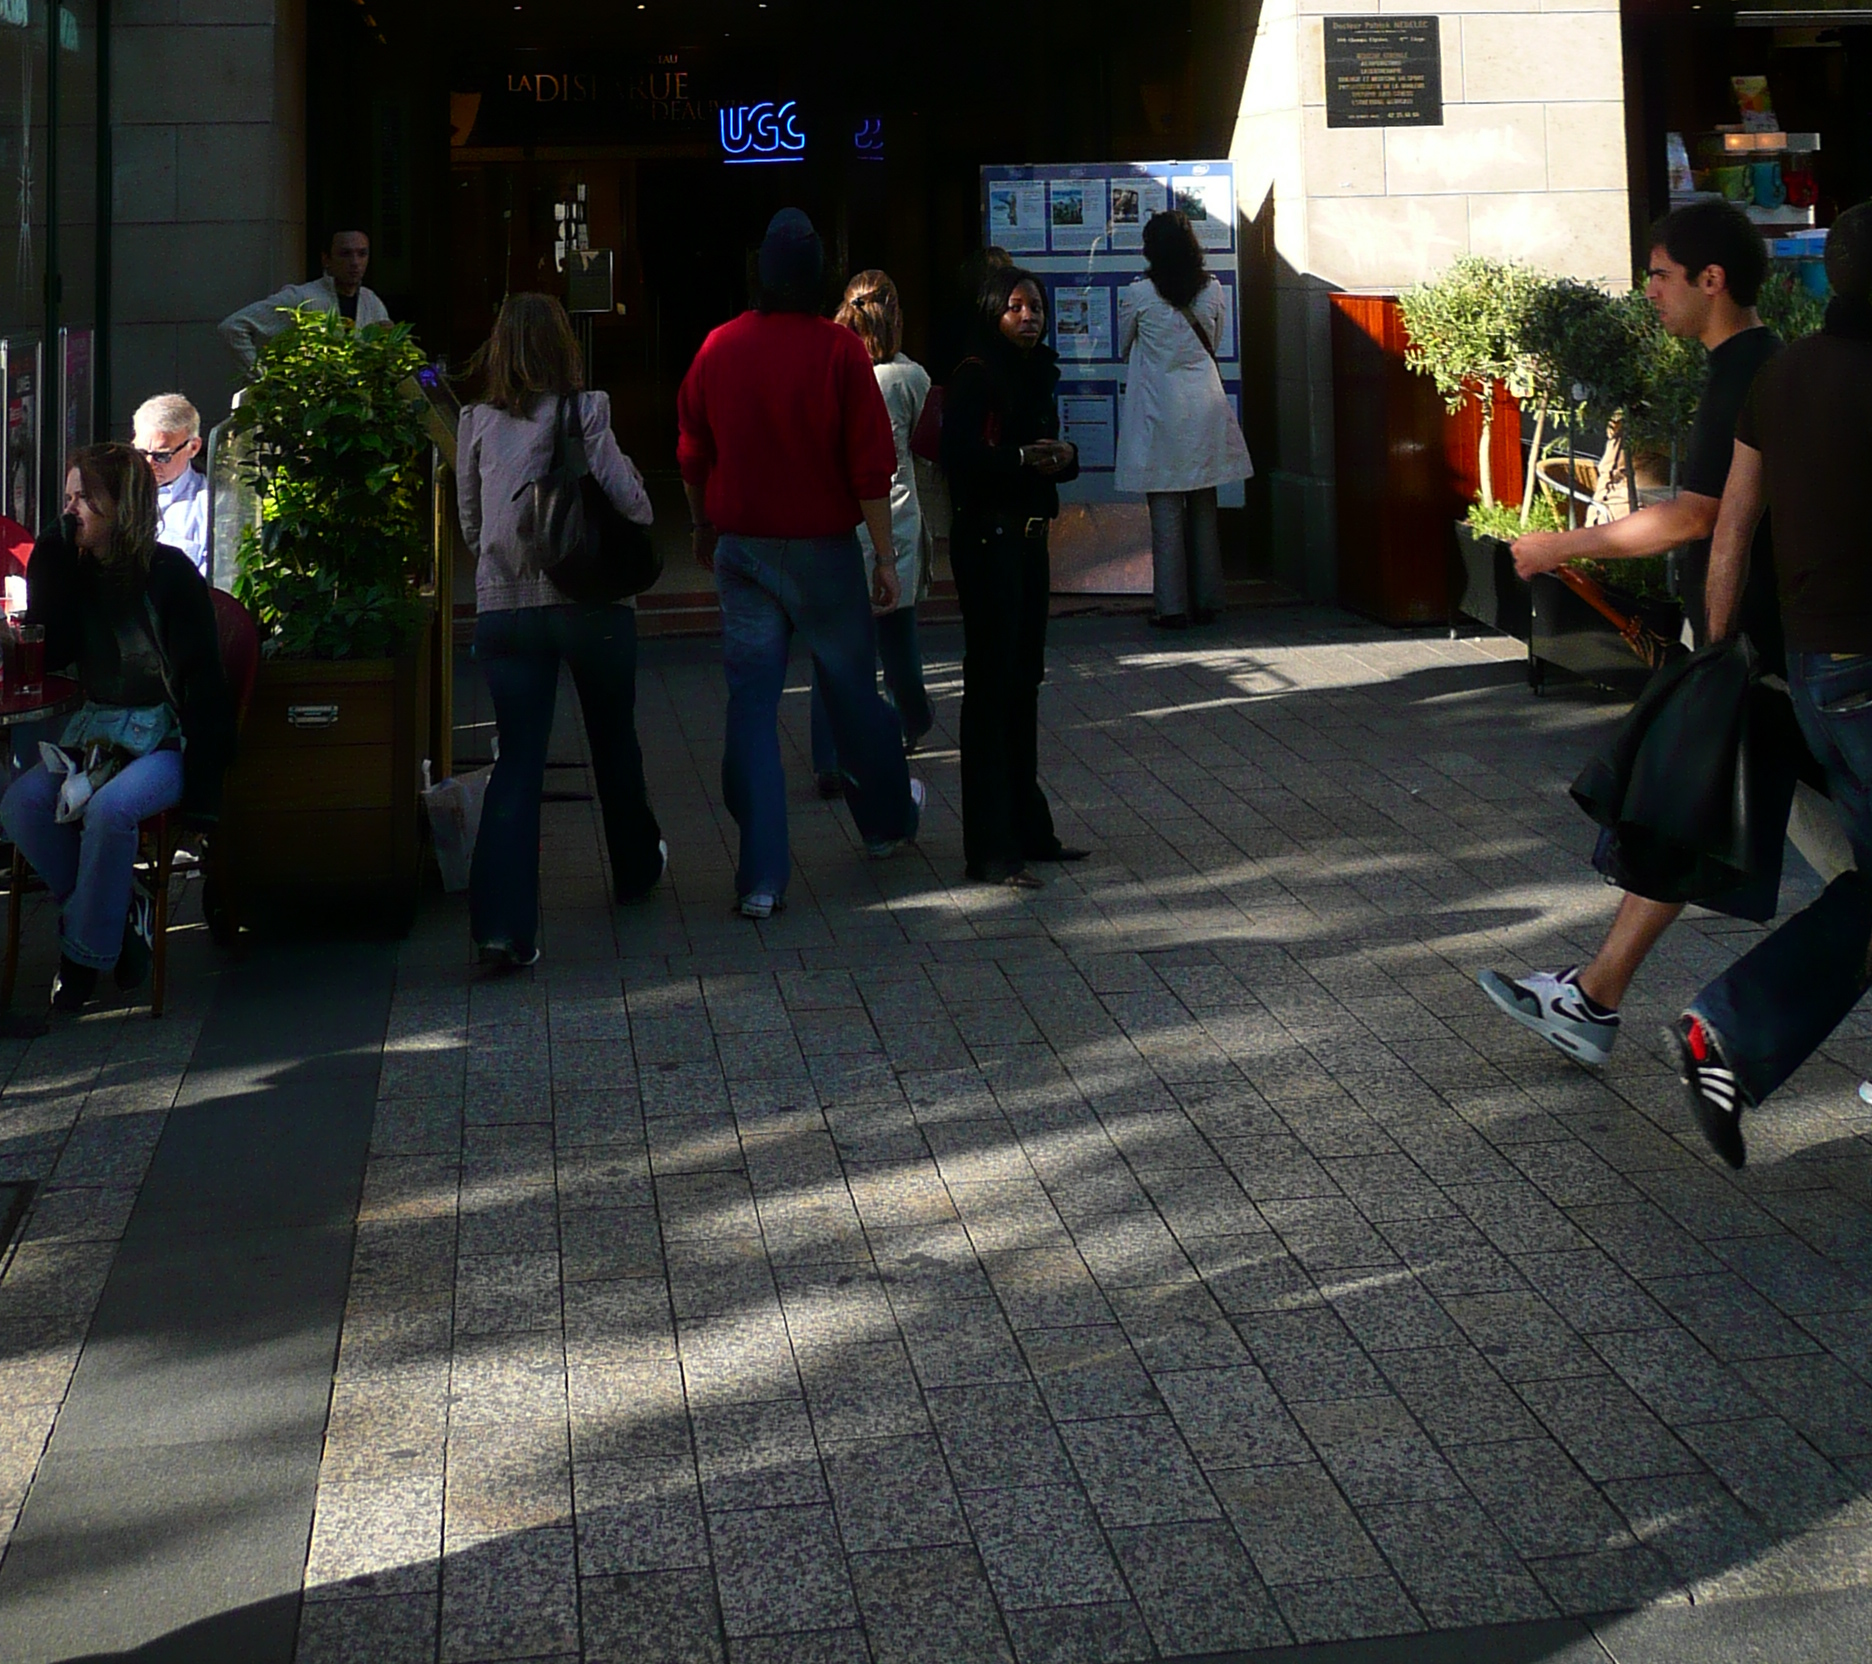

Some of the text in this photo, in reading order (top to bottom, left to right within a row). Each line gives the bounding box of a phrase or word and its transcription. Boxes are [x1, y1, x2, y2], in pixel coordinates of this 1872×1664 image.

[507, 71, 690, 103] LA DISRUE
[720, 101, 805, 153] UGC
